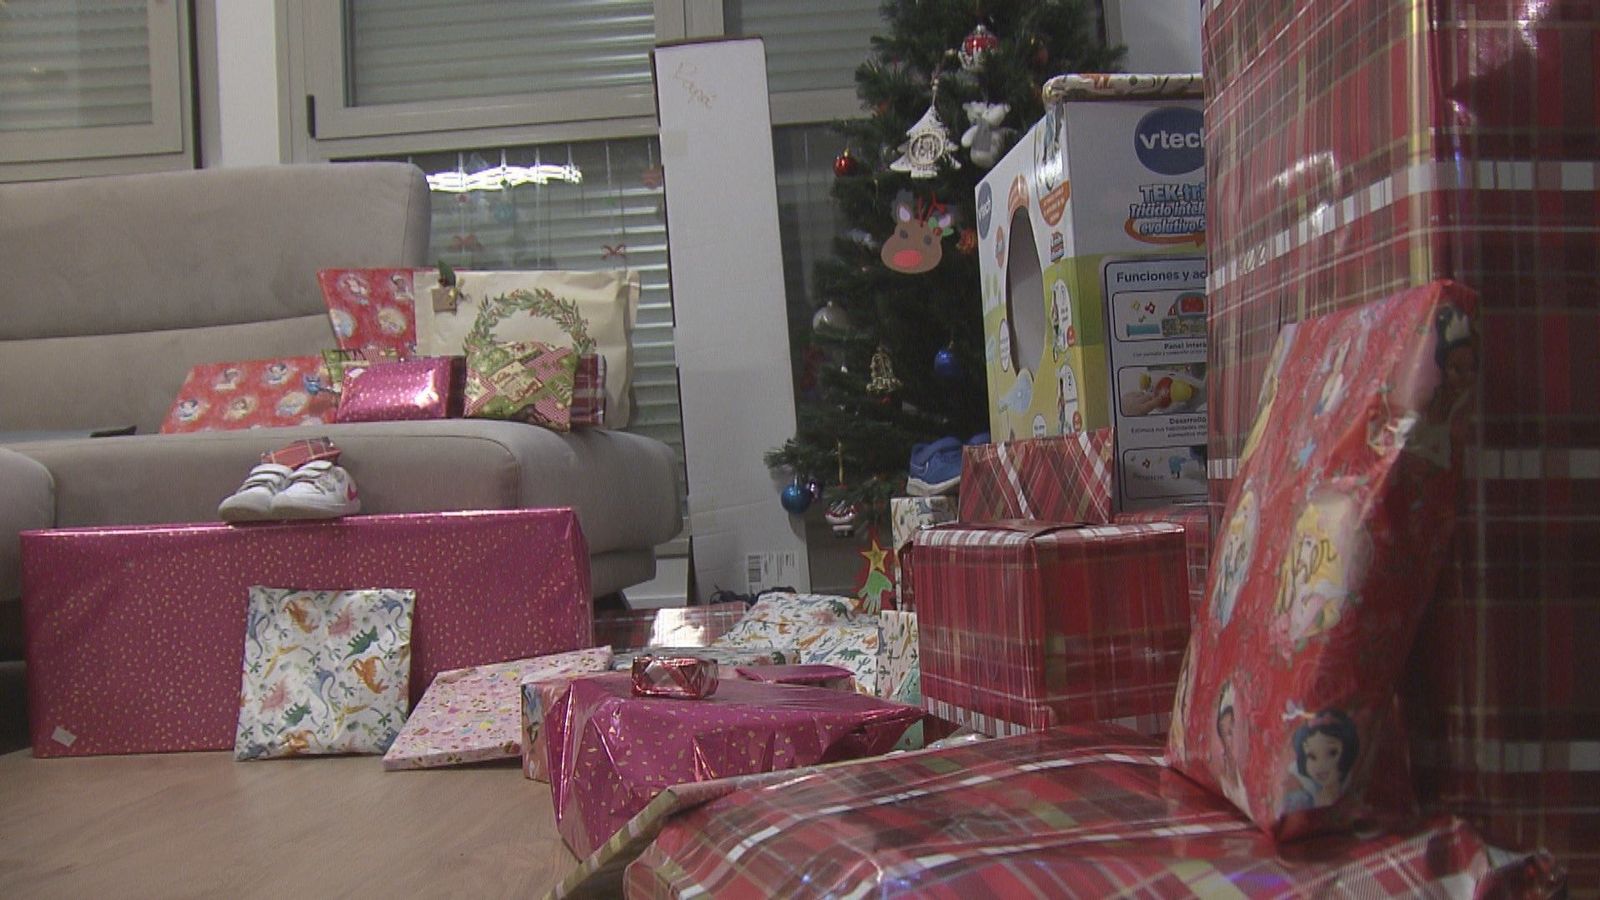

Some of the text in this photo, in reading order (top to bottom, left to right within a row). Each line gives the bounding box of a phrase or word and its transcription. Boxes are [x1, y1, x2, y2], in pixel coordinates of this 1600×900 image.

[1139, 219, 1196, 235] evolutivo
[1116, 271, 1179, 283] Funciones
[1182, 271, 1190, 281] y
